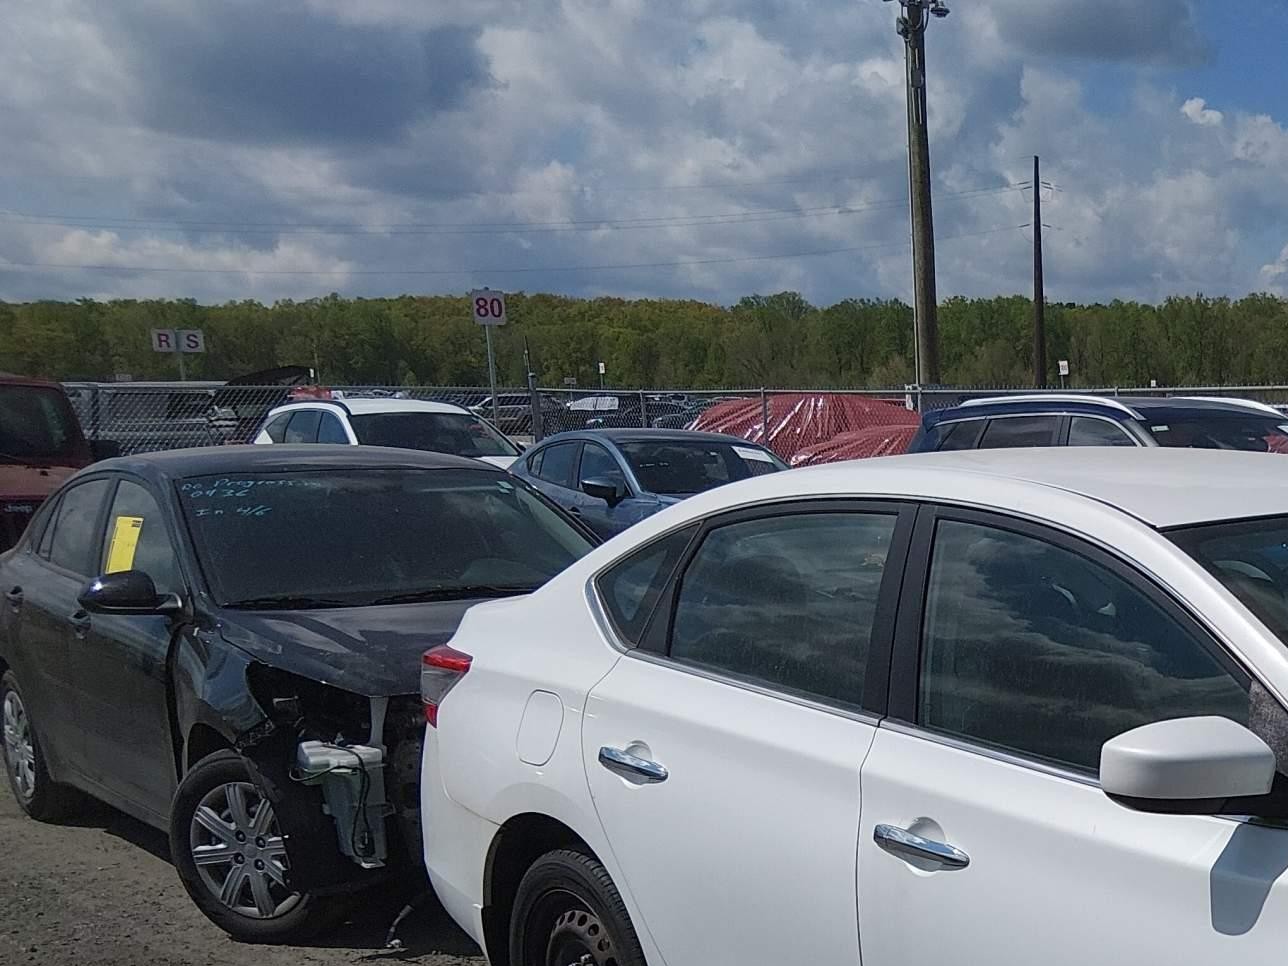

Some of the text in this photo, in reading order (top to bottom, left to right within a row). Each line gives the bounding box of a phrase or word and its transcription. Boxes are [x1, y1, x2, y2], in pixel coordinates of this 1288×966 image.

[475, 297, 503, 318] 80
[158, 333, 170, 348] R
[186, 333, 200, 349] S
